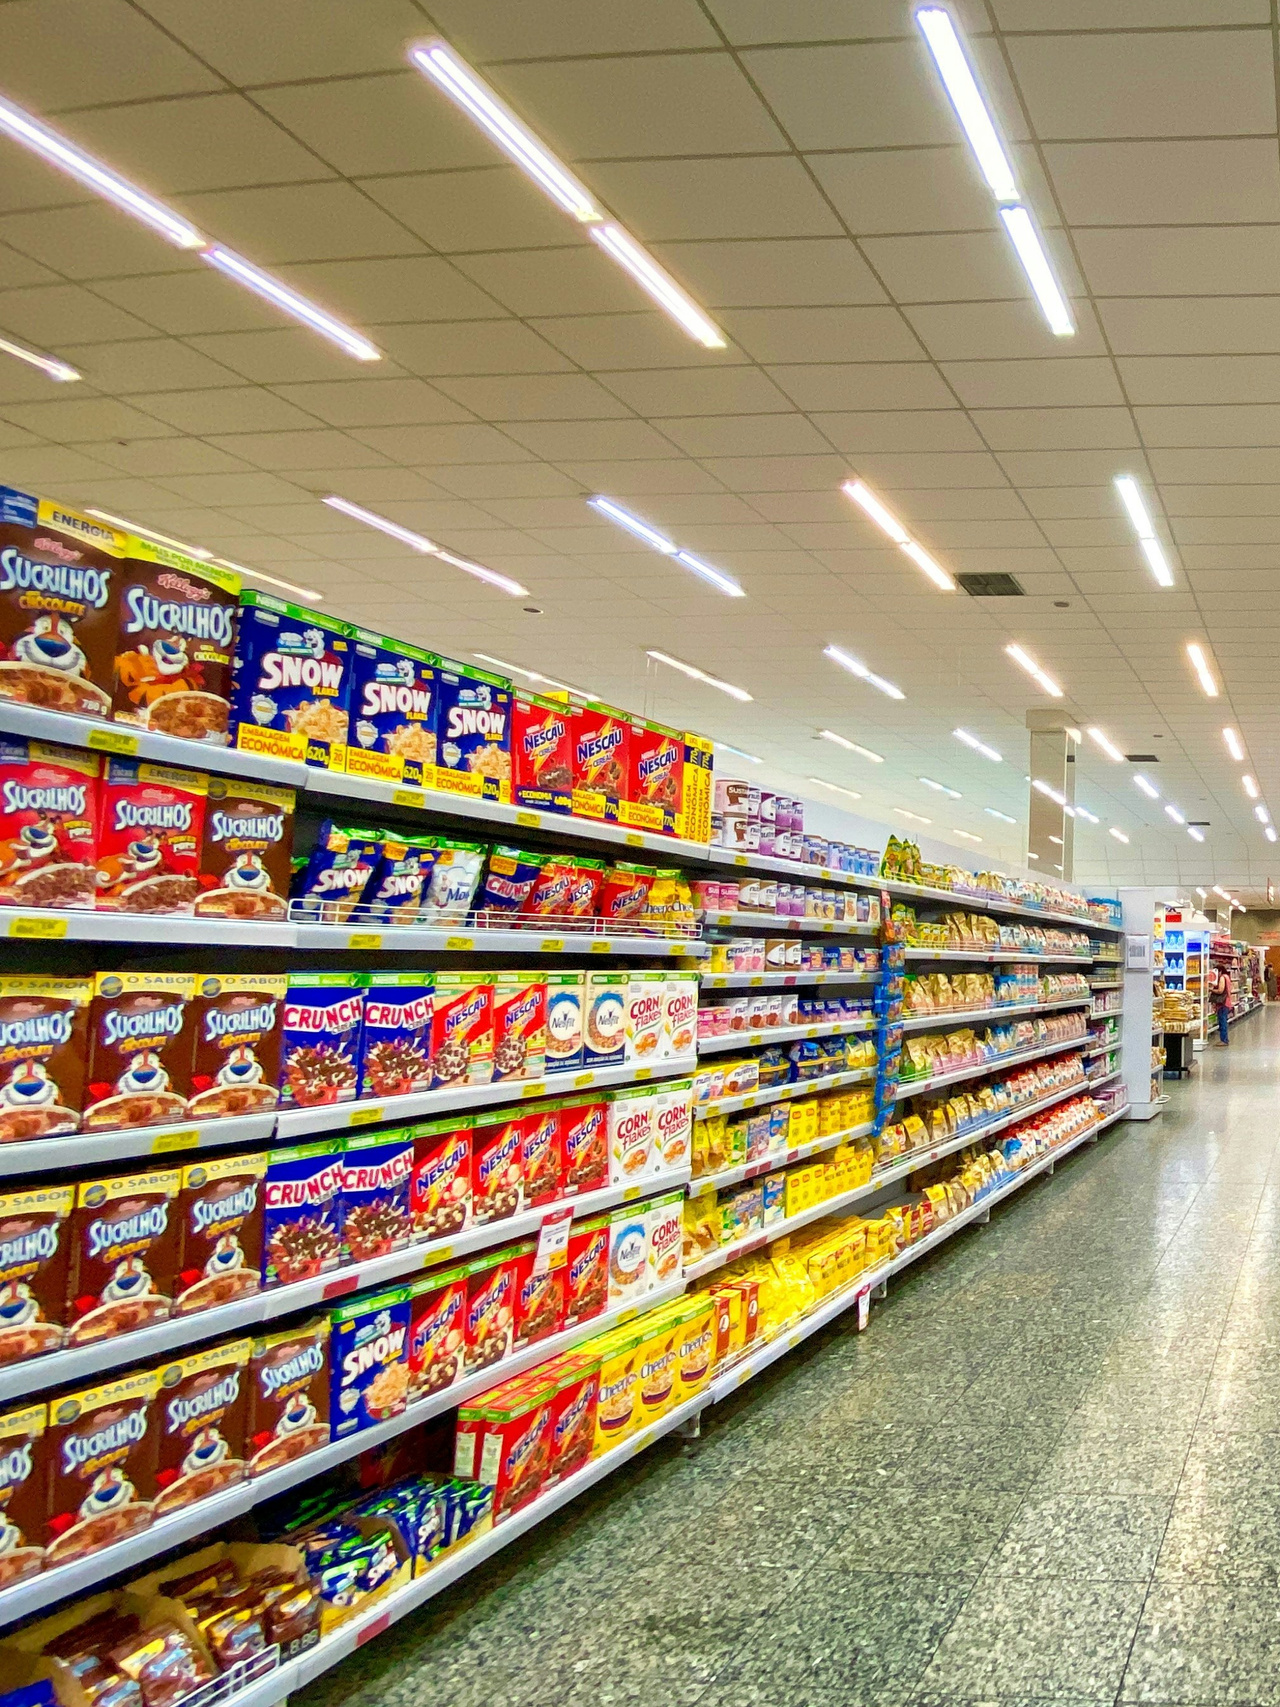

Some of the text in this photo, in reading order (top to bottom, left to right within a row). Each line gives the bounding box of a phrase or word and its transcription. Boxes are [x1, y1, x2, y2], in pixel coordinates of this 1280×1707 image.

[53, 510, 115, 541] ENERGIA
[0, 548, 110, 608] SUCRILHOS
[125, 586, 235, 647] SUCRILHOS
[259, 652, 344, 690] SNOW
[362, 682, 432, 716] SNOW
[241, 725, 291, 743] EMBALAGEM
[448, 706, 506, 738] SNOW
[524, 722, 565, 752] NESCAU
[240, 736, 304, 761] ECONÔMICA
[349, 749, 390, 764] EMBALAGEM
[577, 727, 623, 763] NESCAU
[349, 759, 402, 781] ECONÔMICA
[436, 768, 472, 782] EMBALAGEM
[638, 746, 678, 780] NESCAU
[3, 779, 86, 815] SUCRILHOS
[436, 777, 482, 796] ECONÔMICA
[115, 800, 193, 831] SUCRILHOS
[212, 811, 284, 842] SUCRILHOS
[312, 868, 373, 893] SNOW
[533, 876, 570, 904] NESCAU
[611, 884, 648, 911] NESCAU
[144, 976, 195, 985] SABOR
[240, 977, 286, 985] SABOR
[284, 998, 362, 1030] CRUNCH
[366, 997, 434, 1028] CRUNCH
[445, 994, 488, 1032] NESCAU
[505, 991, 542, 1028] NESCAU
[630, 996, 660, 1019] CORN
[635, 1009, 662, 1031] flakes
[667, 994, 693, 1016] CORN
[672, 1006, 695, 1028] flakes
[105, 1004, 184, 1046] SUCRILHOS
[205, 1002, 277, 1042] SUCRILHOS
[566, 1110, 602, 1154] NESCAU
[617, 1111, 648, 1139] CORN
[658, 1104, 686, 1130] CORN
[663, 1116, 689, 1142] flakes
[623, 1123, 650, 1149] flakes
[225, 1156, 267, 1170] SABOR
[342, 1151, 413, 1190] CRUNCH
[416, 1140, 468, 1196] NESCAU
[479, 1131, 520, 1181] NESCAU
[128, 1172, 180, 1187] SABOR
[266, 1164, 344, 1206] CRUNCH
[12, 1189, 72, 1206] SABOR
[192, 1182, 258, 1233] SUCRILHOS
[88, 1202, 169, 1257] SUCRILHOS
[652, 1217, 679, 1247] CORN
[571, 1235, 607, 1284] NESCAU
[468, 1271, 511, 1329] NESCAU
[413, 1291, 463, 1355] NESCAU
[202, 1341, 249, 1364] SABOR
[340, 1327, 406, 1387] SNOW
[680, 1330, 712, 1357] Cheerios
[260, 1342, 324, 1398] SUCRILHOS
[641, 1351, 676, 1379] Cheerios
[103, 1374, 158, 1396] SABOR
[599, 1371, 637, 1402] Cheerios
[168, 1371, 241, 1432] SUCRILHOS
[555, 1380, 596, 1441] NESCAU
[62, 1406, 148, 1474] SUCRILHOS
[506, 1407, 550, 1473] NESCAU
